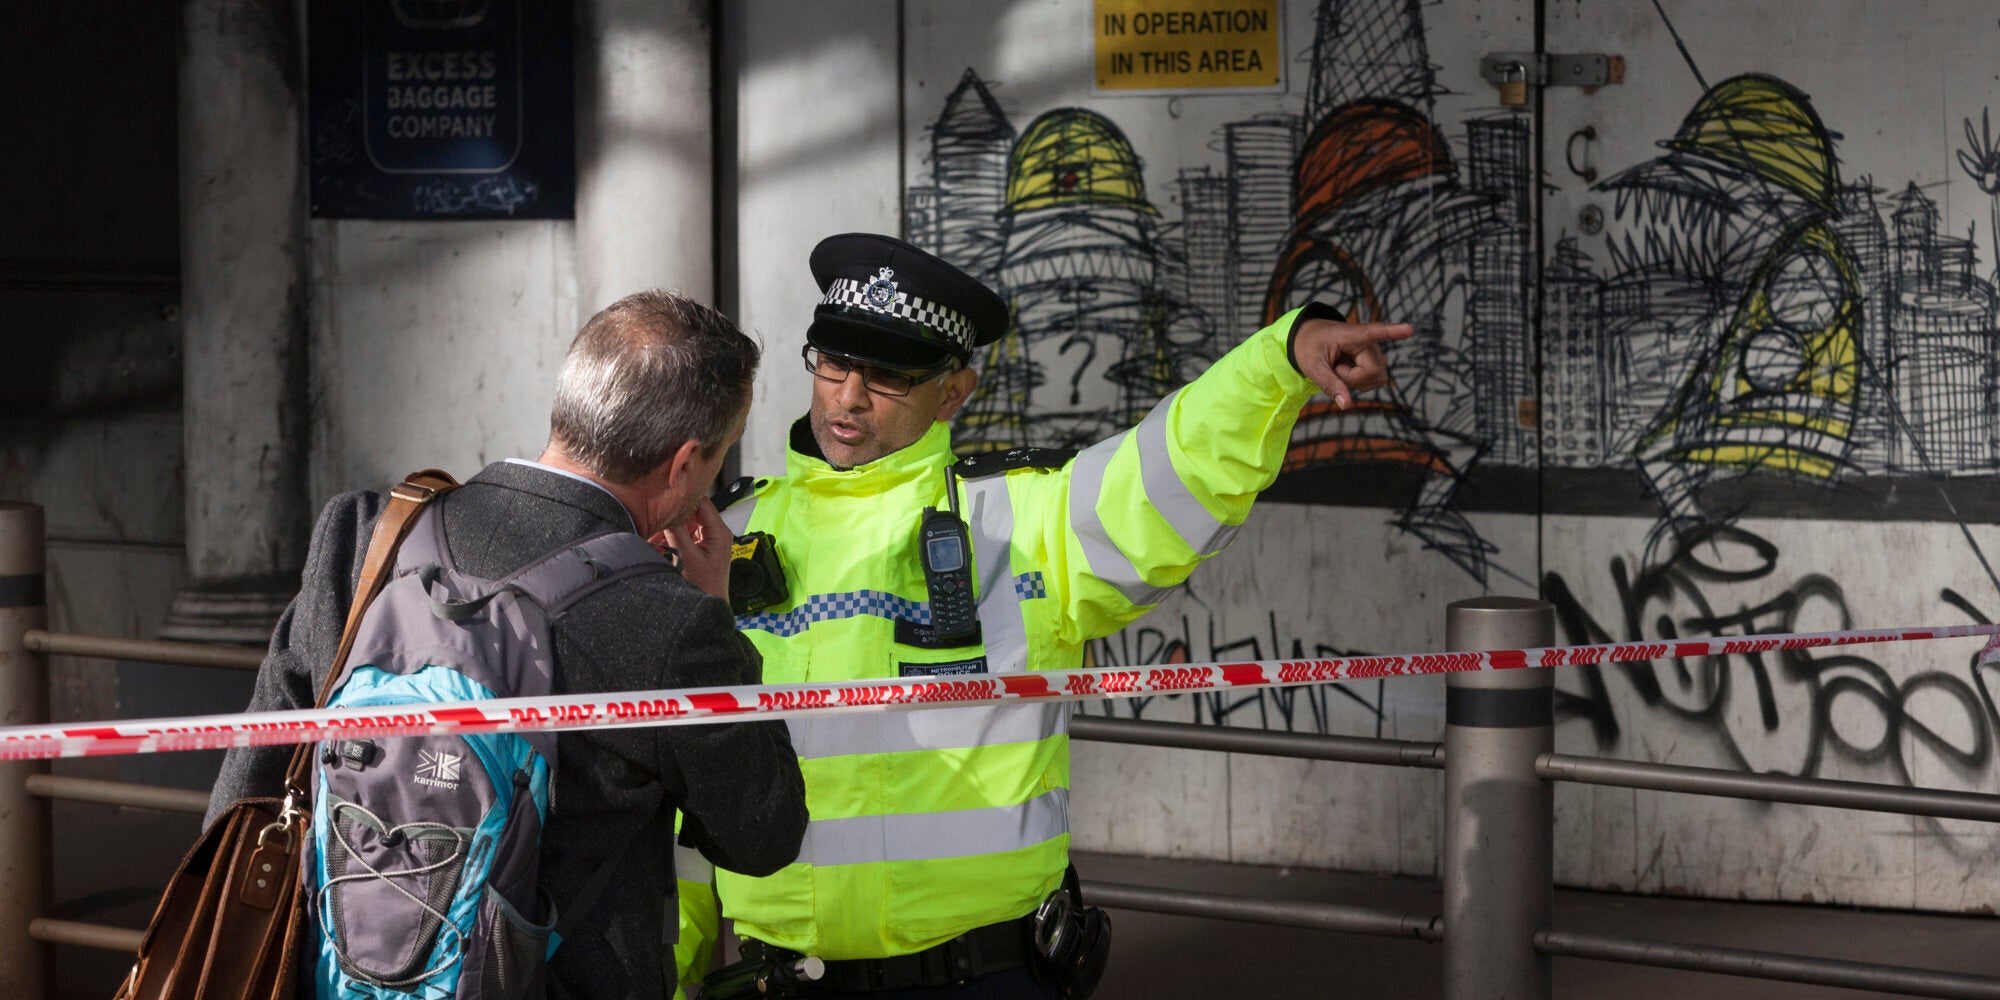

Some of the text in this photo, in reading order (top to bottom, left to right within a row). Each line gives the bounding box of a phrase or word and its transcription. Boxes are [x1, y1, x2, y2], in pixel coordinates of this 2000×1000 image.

[1104, 9, 1268, 35] IN OPERATION
[387, 51, 497, 80] EXCESS
[1110, 49, 1263, 74] IN THIS AREA
[387, 85, 498, 110] BAGGAGE
[387, 115, 496, 139] COMPANY
[930, 663, 977, 674] METROPOLITAN
[413, 774, 459, 791] karrimor
